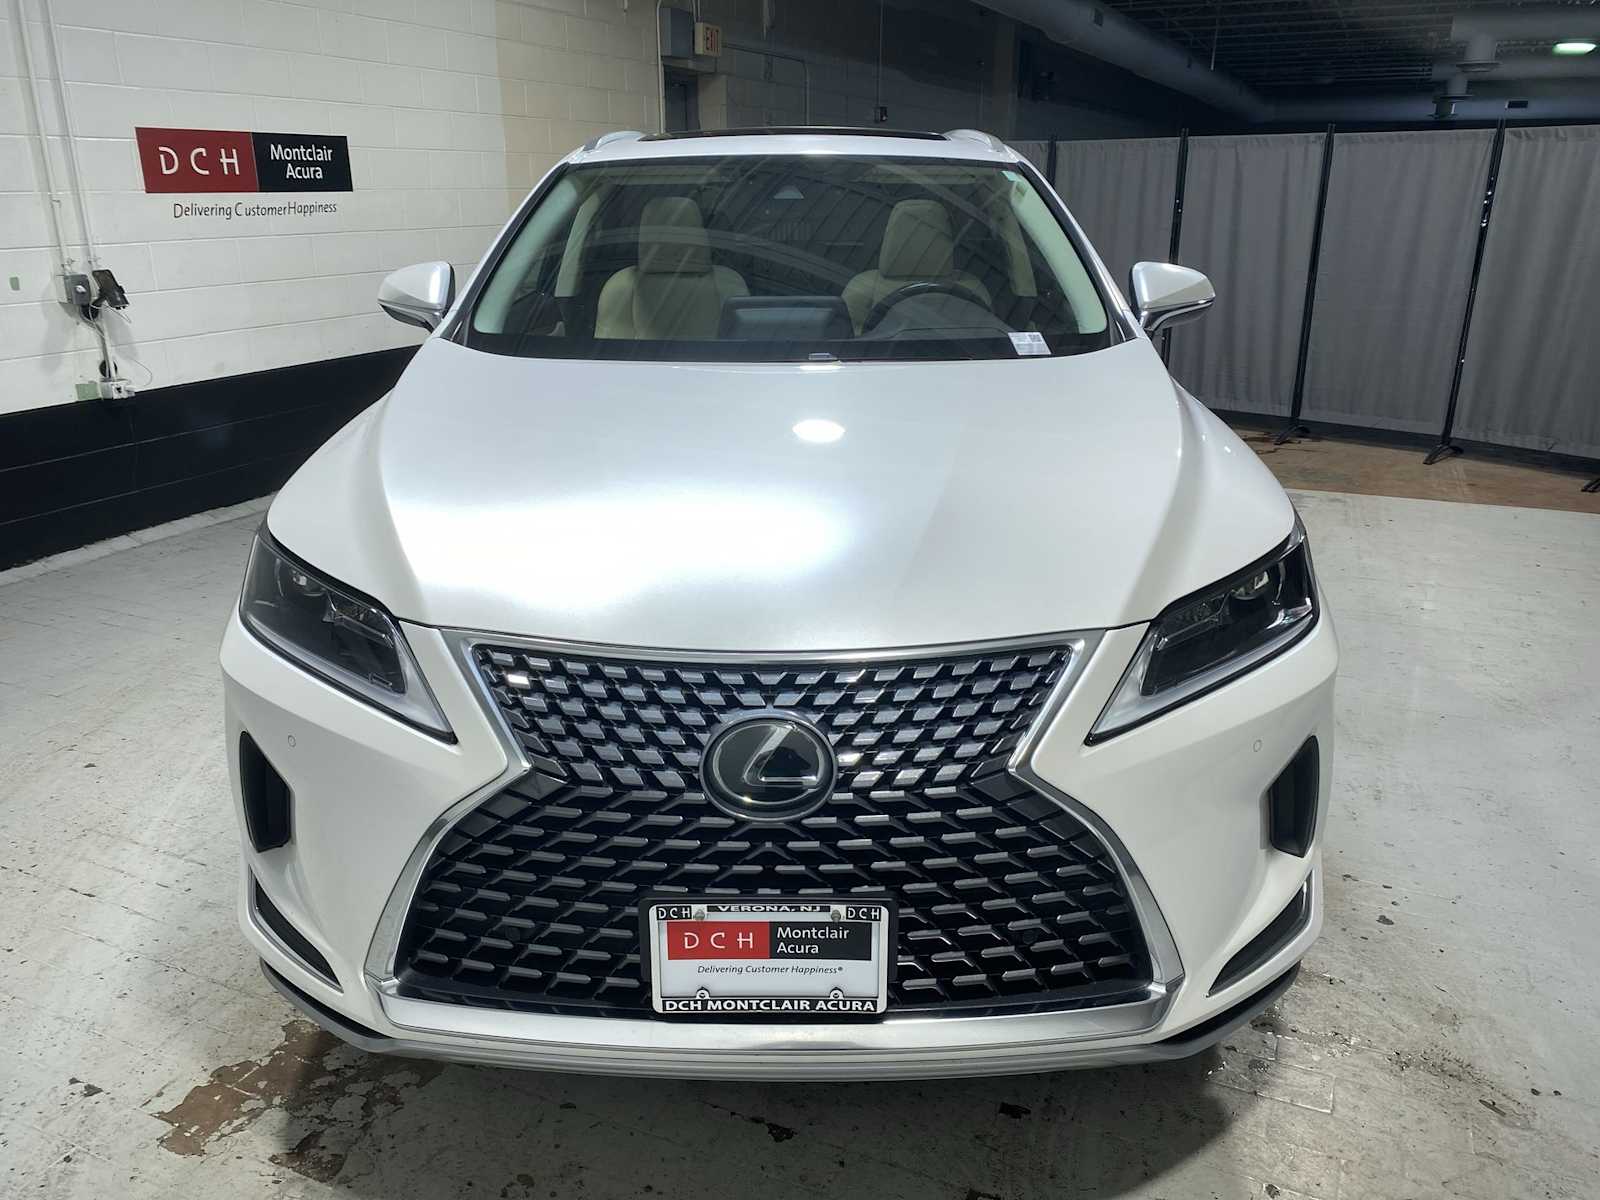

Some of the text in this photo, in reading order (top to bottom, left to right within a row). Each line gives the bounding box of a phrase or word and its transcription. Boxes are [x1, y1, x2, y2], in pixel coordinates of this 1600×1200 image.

[270, 143, 333, 162] Montclair
[285, 163, 323, 179] Acura
[173, 201, 337, 219] Delivering Customer Happiness
[658, 907, 691, 919] DCH
[847, 907, 880, 920] DCH
[777, 926, 850, 940] Montclair
[684, 932, 753, 949] DCH
[776, 941, 819, 954] Acura
[697, 965, 743, 974] Delivering
[745, 965, 789, 974] Customer
[665, 999, 875, 1011] DCH MONTCLAIR ACURA
